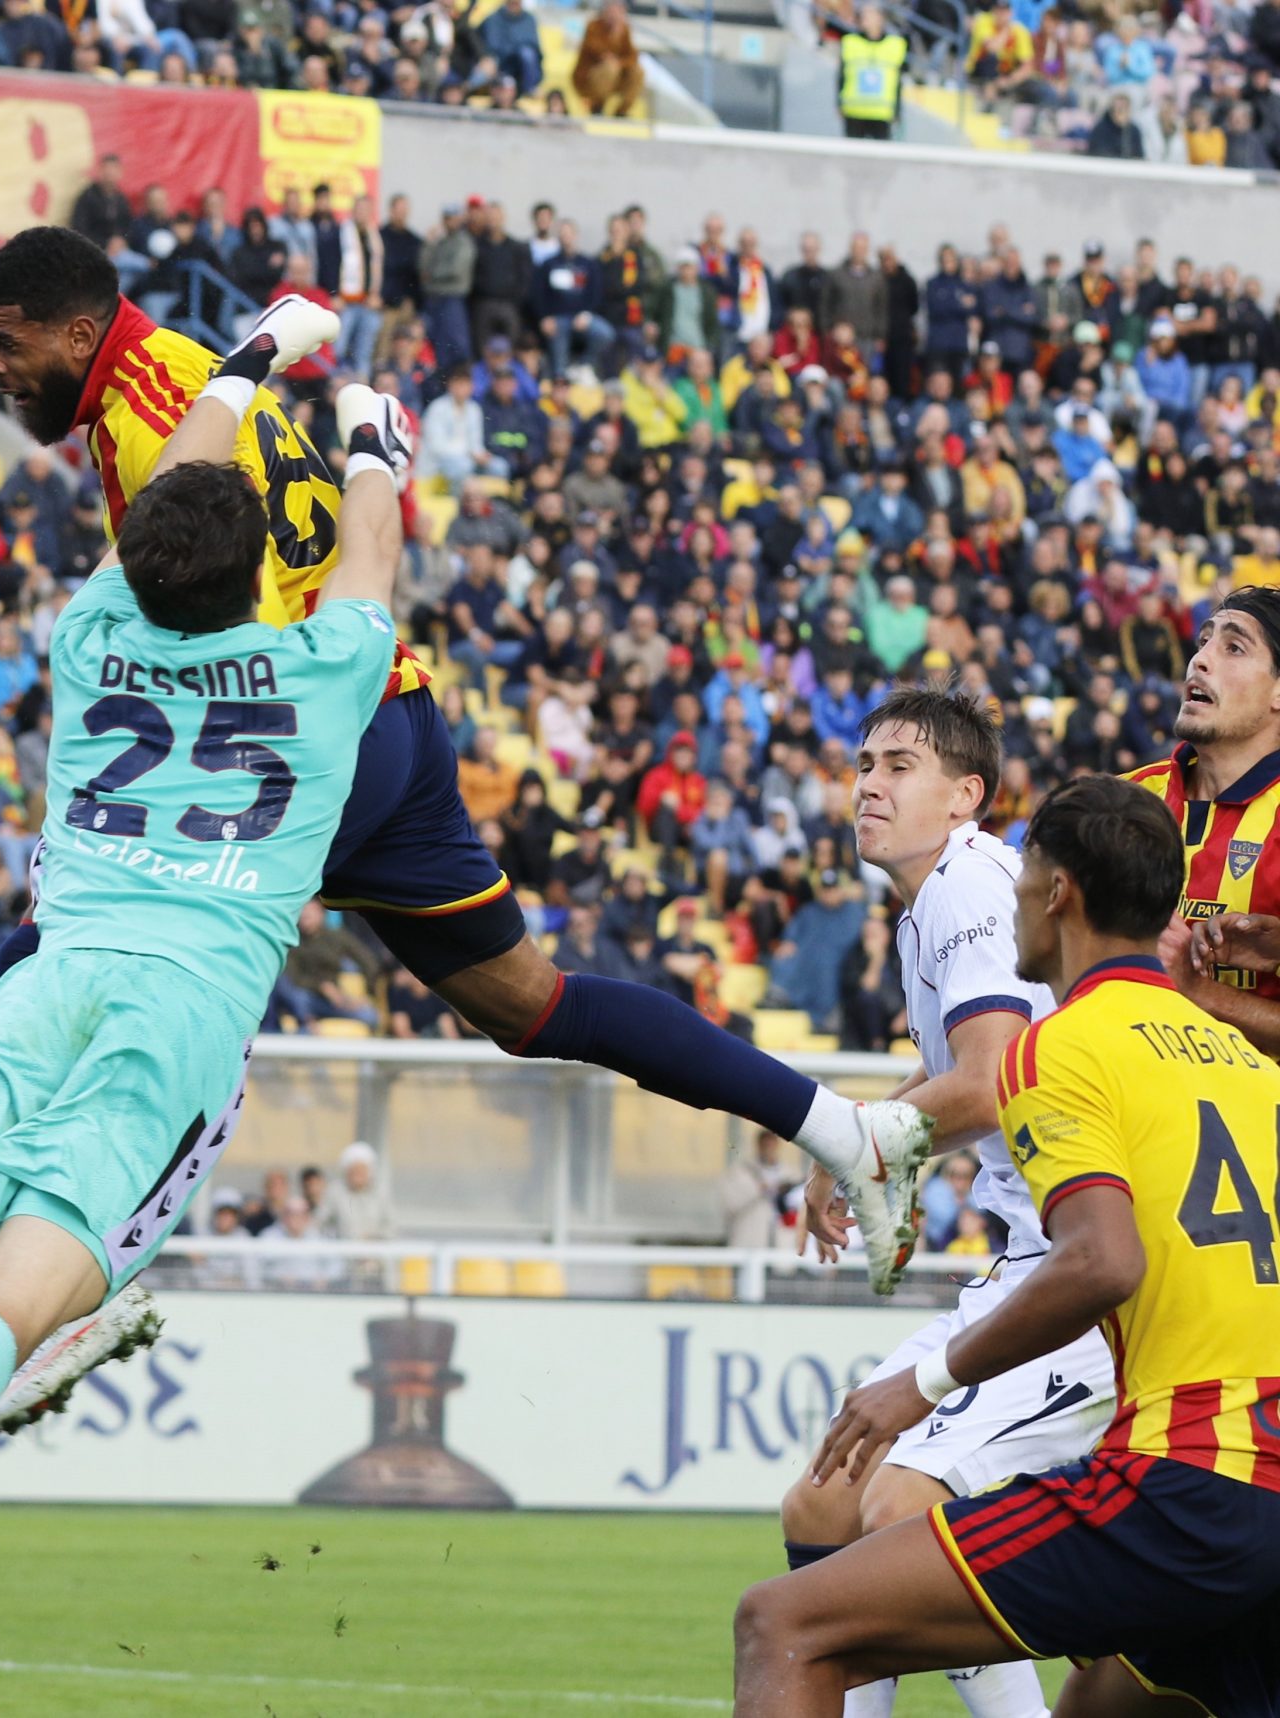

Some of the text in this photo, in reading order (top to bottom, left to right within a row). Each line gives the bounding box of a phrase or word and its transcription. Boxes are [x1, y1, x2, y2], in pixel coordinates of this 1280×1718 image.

[66, 694, 298, 842] 25
[1196, 903, 1221, 918] PAY
[1130, 1022, 1234, 1066] TIAGO
[1176, 1098, 1280, 1285] 4
